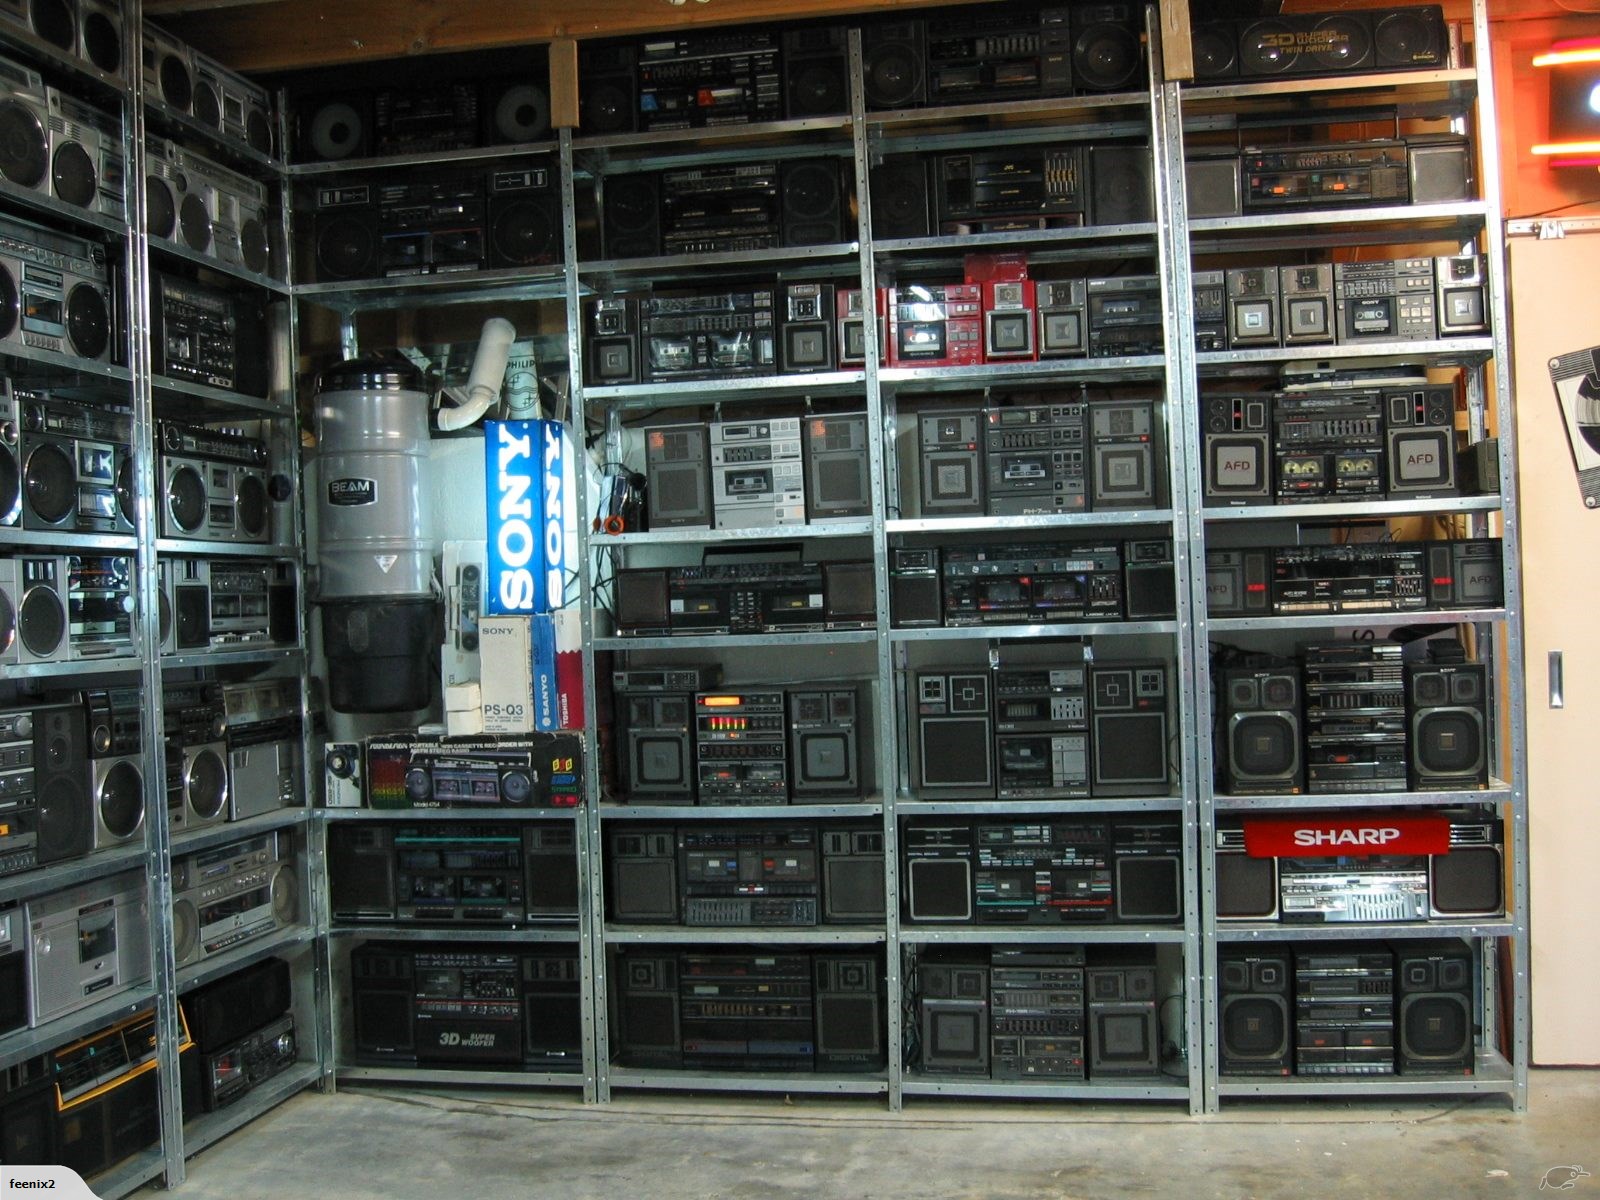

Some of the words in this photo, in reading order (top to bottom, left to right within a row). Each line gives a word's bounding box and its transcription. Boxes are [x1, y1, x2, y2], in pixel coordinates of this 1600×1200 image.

[1280, 46, 1304, 54] TWIN
[1305, 44, 1334, 53] DRIVE
[507, 360, 537, 369] PHILIP
[1407, 454, 1434, 465] AFD
[1224, 461, 1250, 471] AFD
[332, 481, 370, 493] BEAM
[498, 423, 534, 609] SONY
[546, 423, 562, 608] SONY
[1470, 576, 1493, 584] AFD
[541, 674, 550, 717] SANYO
[484, 704, 524, 716] PS-Q3
[561, 693, 569, 726] TOSHIBA
[1293, 827, 1401, 846] SHARP
[439, 1032, 460, 1046] 3D
[461, 1039, 495, 1047] WOOFER
